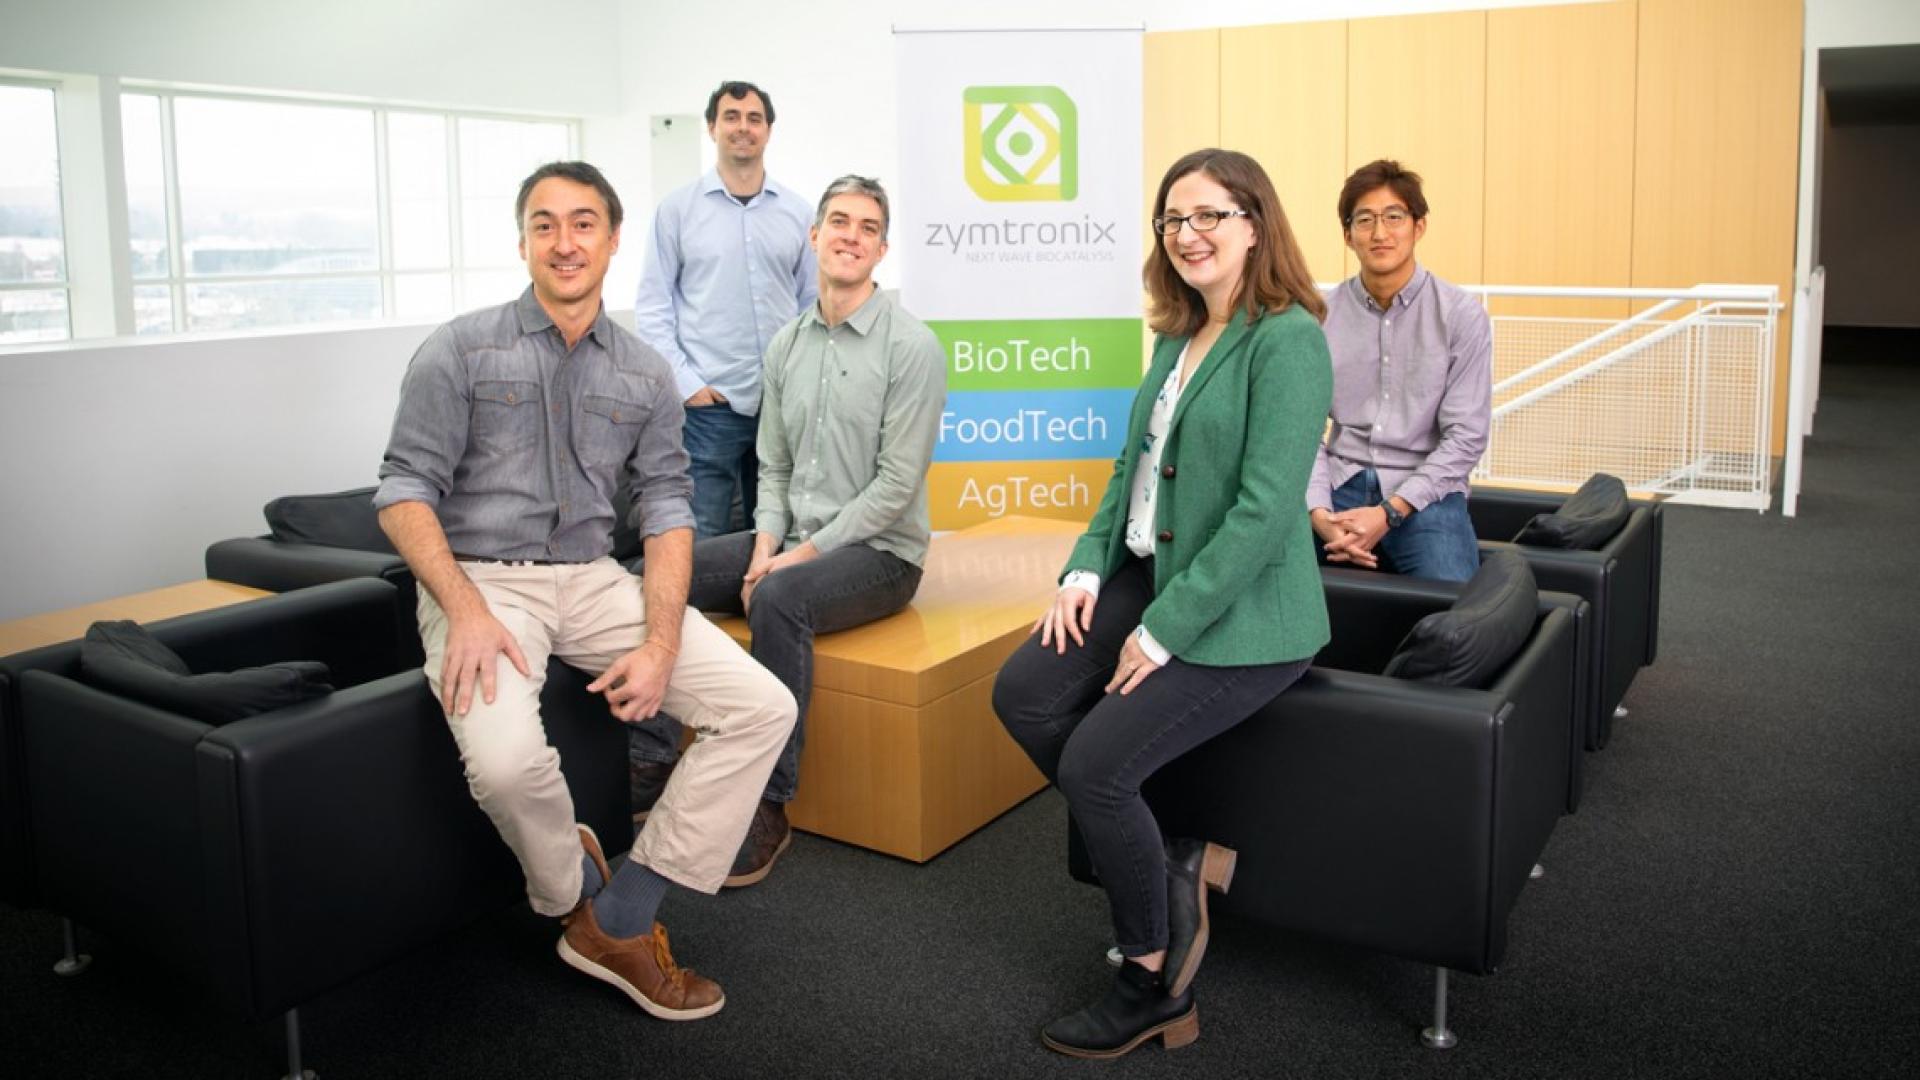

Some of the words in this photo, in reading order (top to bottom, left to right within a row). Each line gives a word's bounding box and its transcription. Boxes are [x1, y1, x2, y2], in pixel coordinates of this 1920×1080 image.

[925, 214, 1116, 254] zymtronix
[966, 251, 994, 263] NEXT
[998, 251, 1031, 262] WAVE
[1036, 250, 1114, 262] BIOCATALYSIS
[953, 337, 1091, 372] BioTech
[939, 407, 1107, 443] FoodTech
[957, 474, 1089, 516] AgTech
